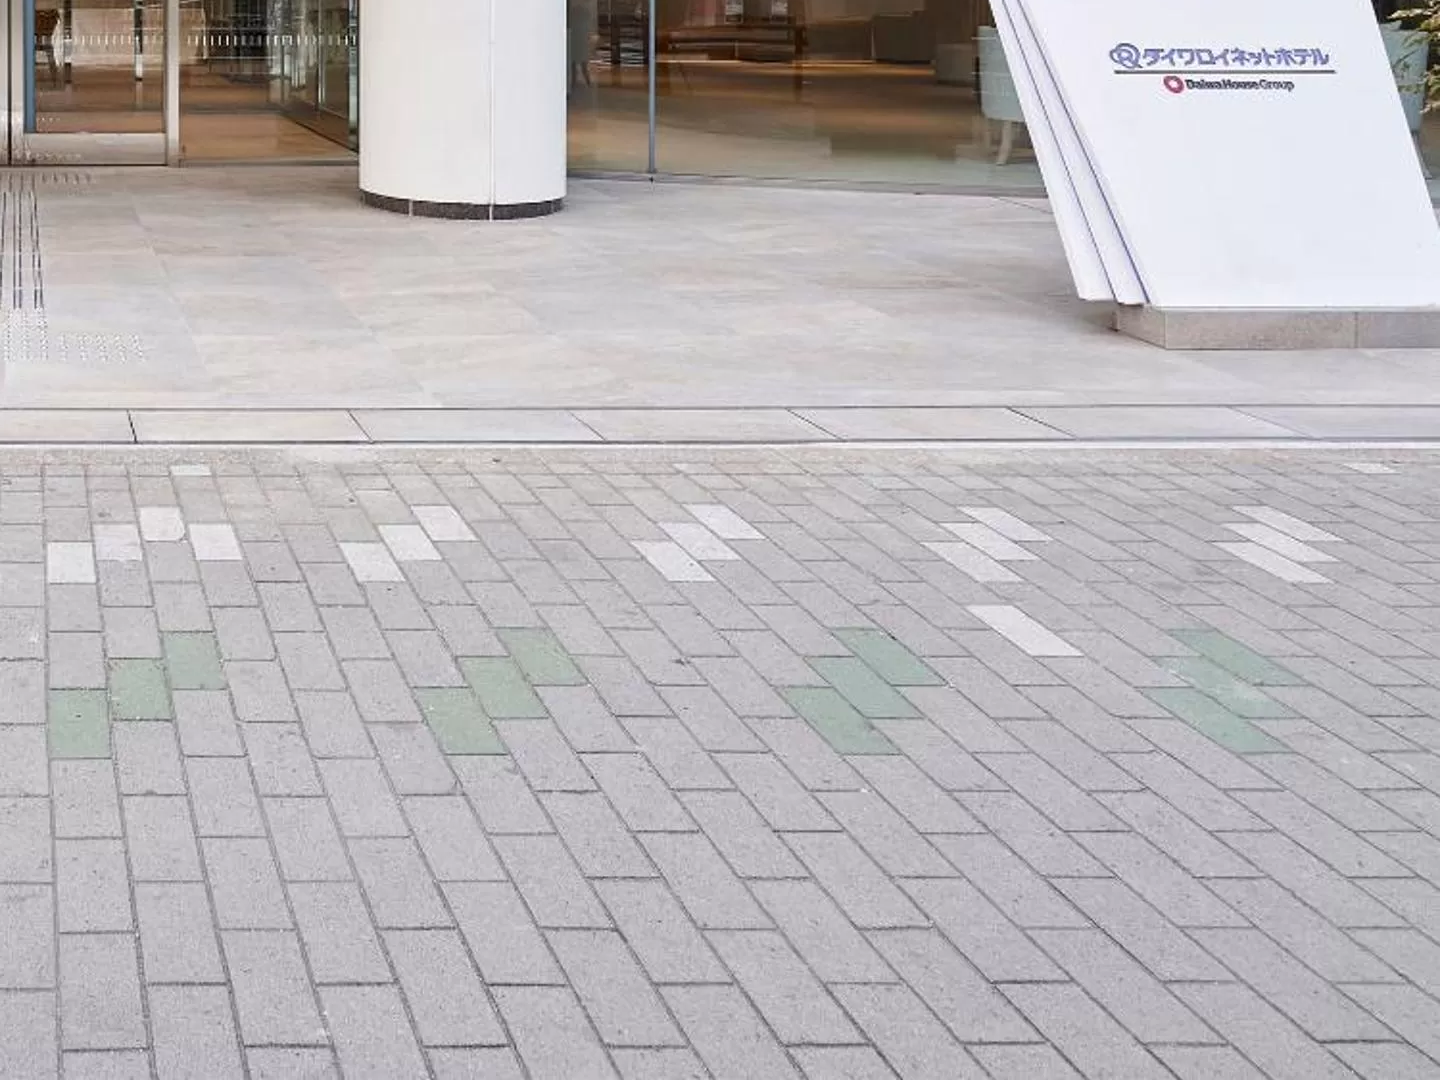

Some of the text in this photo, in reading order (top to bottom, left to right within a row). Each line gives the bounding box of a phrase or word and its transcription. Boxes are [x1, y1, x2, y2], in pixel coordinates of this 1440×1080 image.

[1143, 47, 1329, 67] ダイワロイネットホテル
[1259, 79, 1295, 92] Group
